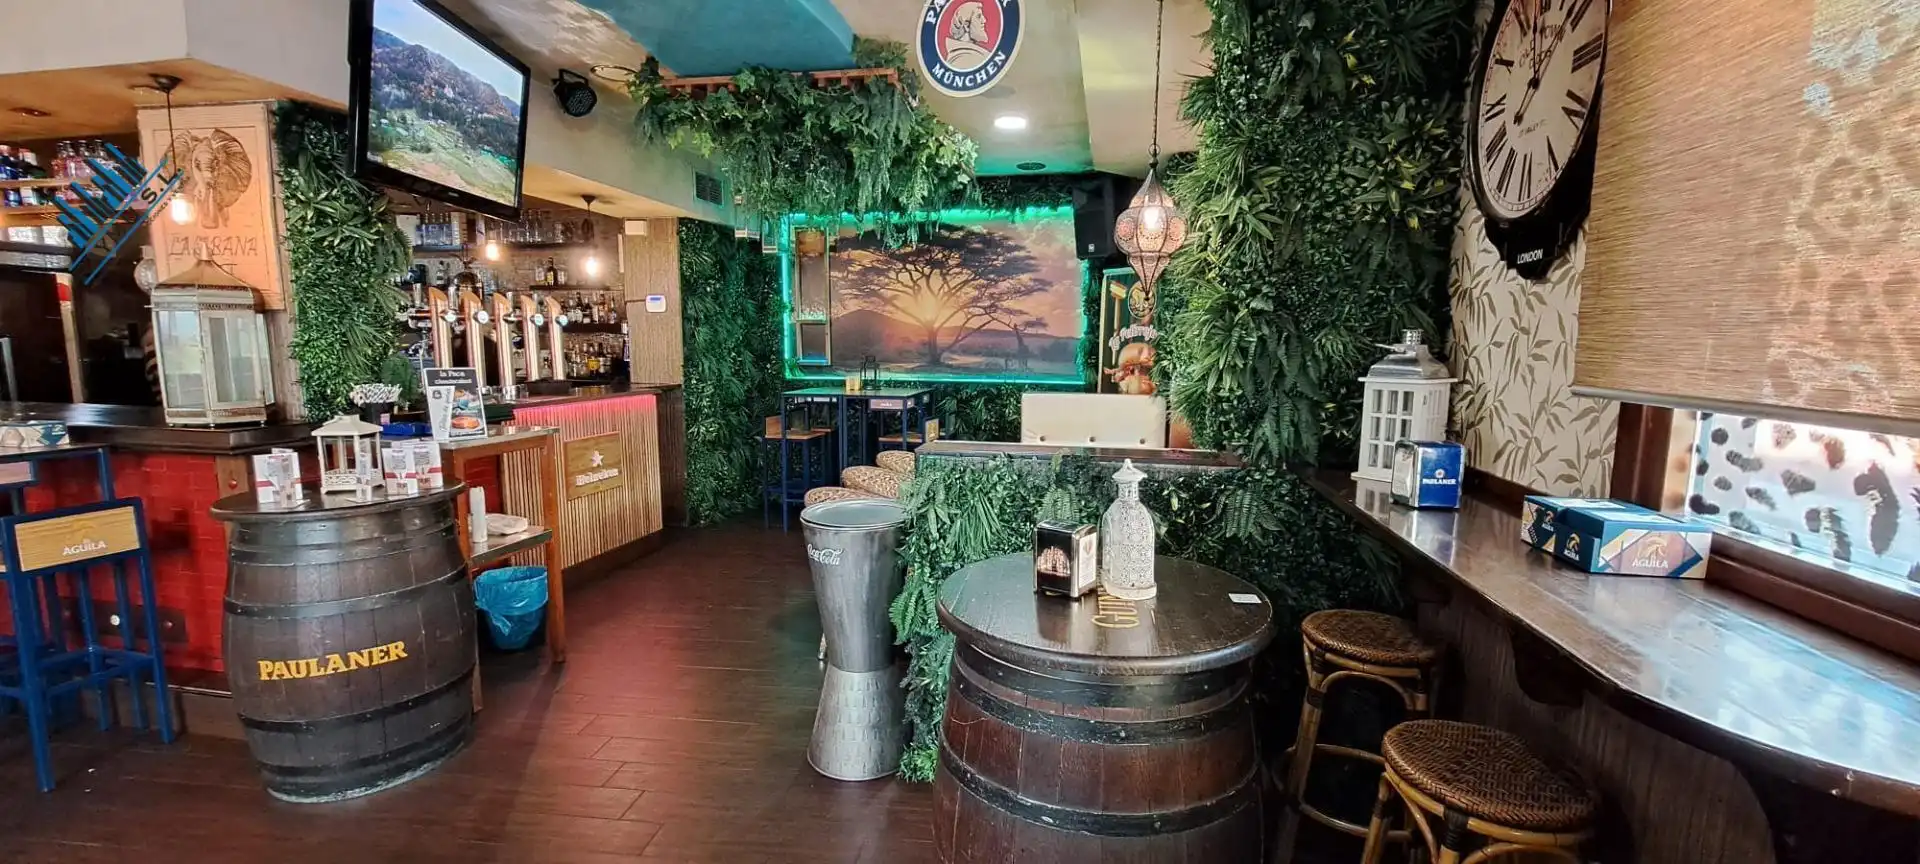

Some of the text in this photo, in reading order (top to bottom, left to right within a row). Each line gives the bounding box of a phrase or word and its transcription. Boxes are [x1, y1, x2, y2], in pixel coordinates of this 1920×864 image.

[932, 51, 1006, 88] MÜNCHEN
[193, 235, 257, 257] SBANA
[1516, 248, 1544, 265] LONDON
[575, 468, 619, 486] Heineken
[62, 540, 107, 556] AGUILA
[1632, 557, 1669, 569] AGUILA
[257, 640, 409, 681] PAULANER
